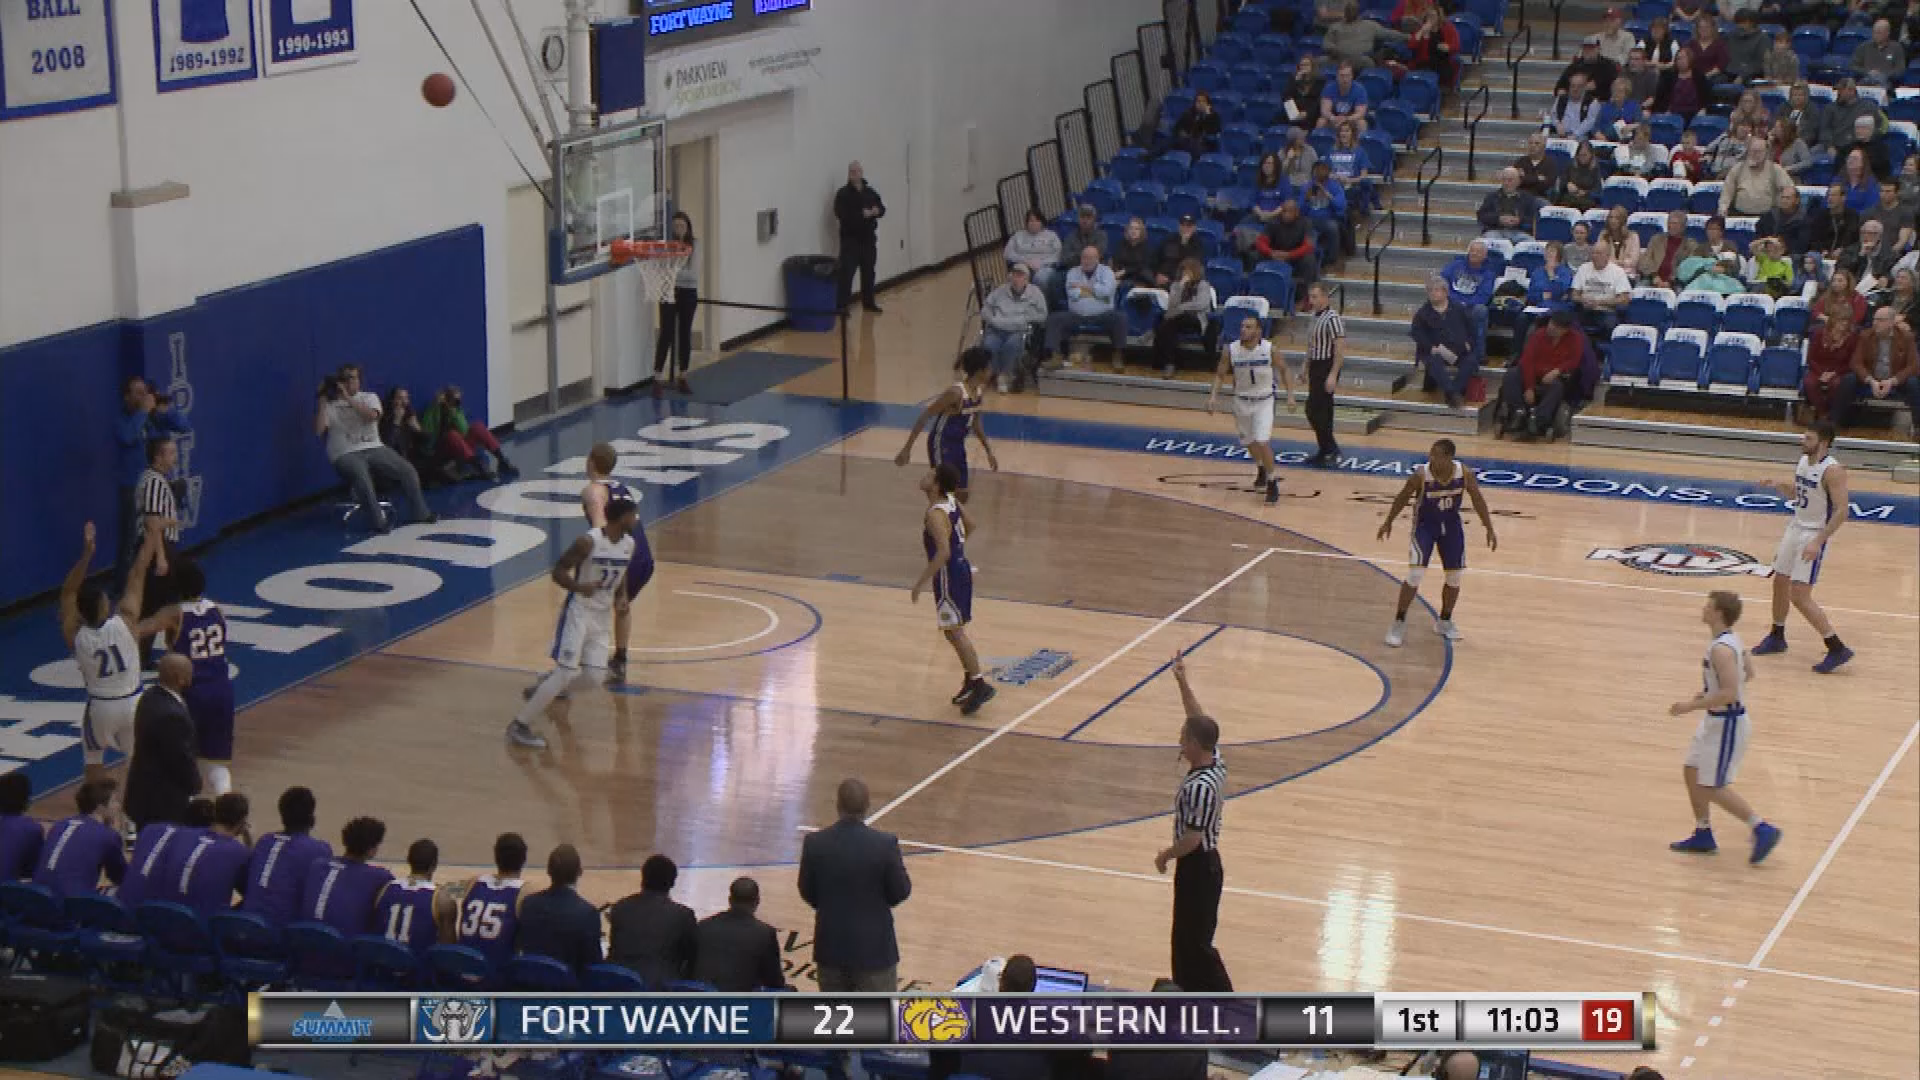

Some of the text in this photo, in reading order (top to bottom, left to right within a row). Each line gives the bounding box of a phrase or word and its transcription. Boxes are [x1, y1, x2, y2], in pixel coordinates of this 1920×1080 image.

[277, 29, 350, 56] 1990-1993
[31, 45, 86, 75] 2008
[169, 47, 245, 73] 1989-1992
[676, 59, 728, 88] PARKVIEW
[1250, 369, 1256, 385] 1
[188, 623, 225, 659] 22
[93, 643, 127, 679] 21
[385, 903, 414, 943] 11
[461, 899, 507, 940] 35
